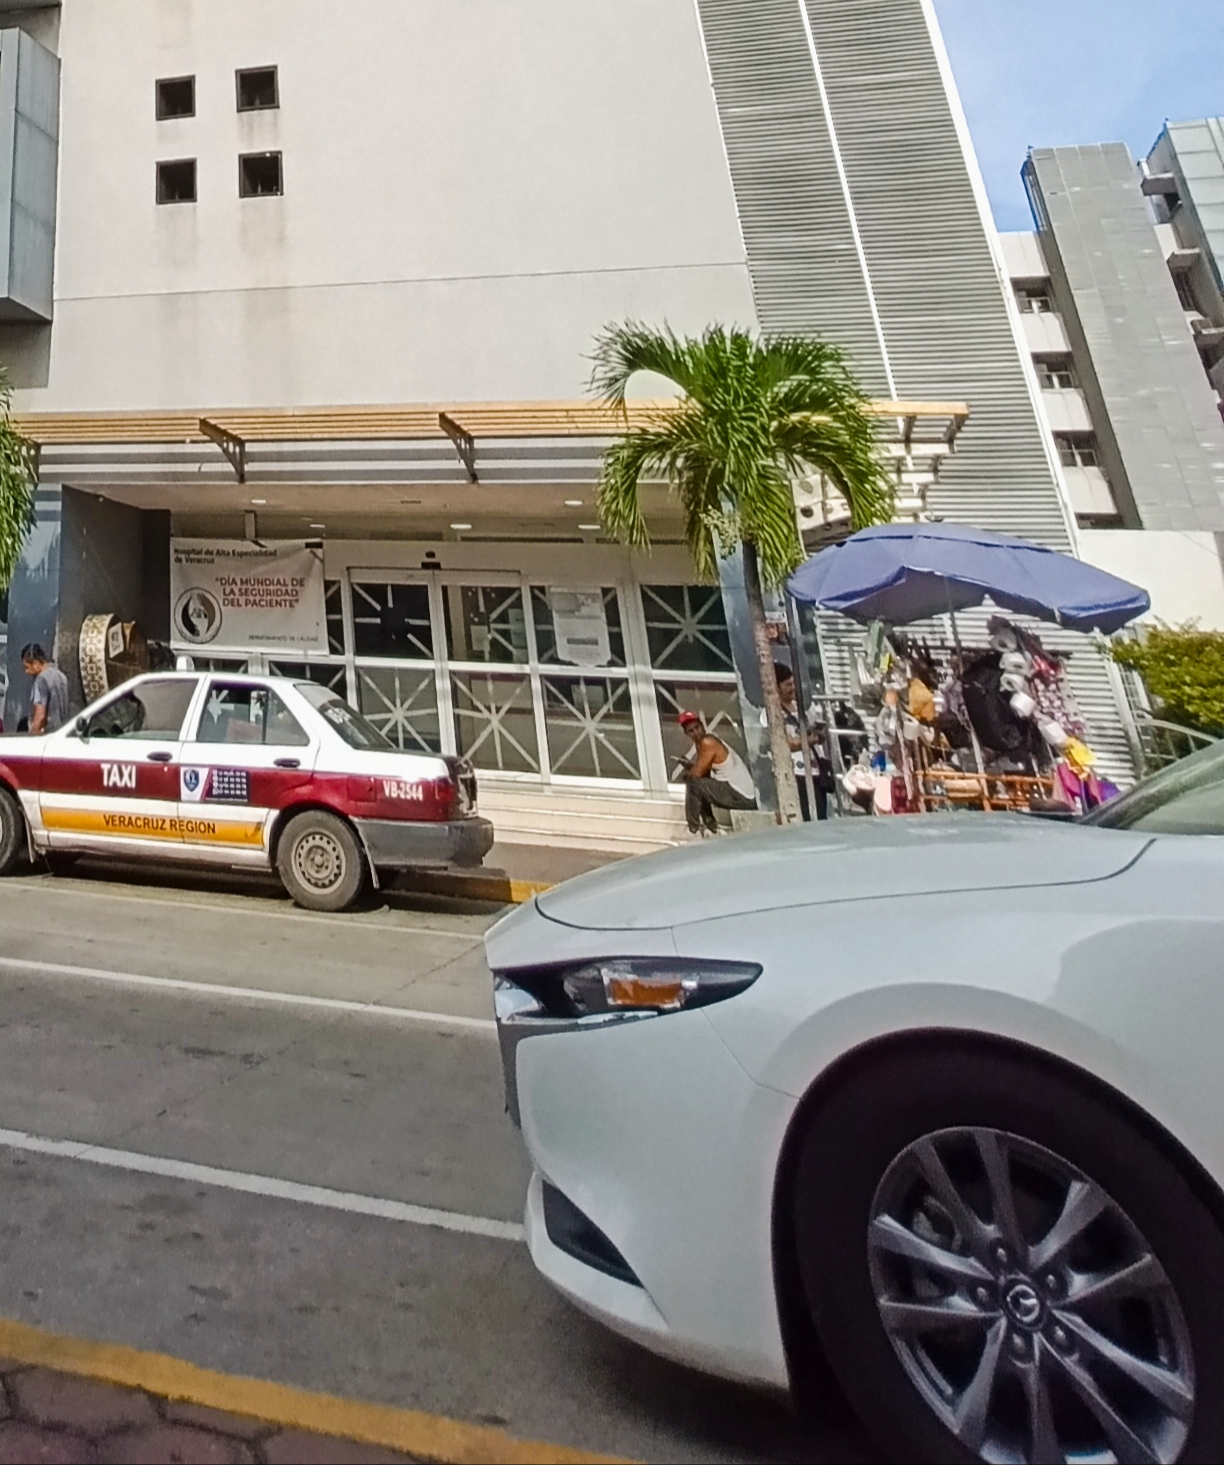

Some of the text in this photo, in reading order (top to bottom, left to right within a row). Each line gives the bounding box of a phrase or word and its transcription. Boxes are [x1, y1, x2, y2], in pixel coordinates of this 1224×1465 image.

[174, 547, 278, 558] Hospital de Alta Especialidad
[174, 555, 215, 564] de Veracruz
[240, 577, 289, 587] MUNDIAL
[291, 577, 305, 587] DE
[222, 587, 299, 597] LA SEGURIDAD
[222, 598, 242, 607] DEL
[100, 763, 136, 789] TAXI
[382, 779, 424, 802] VB-2544
[103, 814, 216, 834] VERACRUZ REGION
